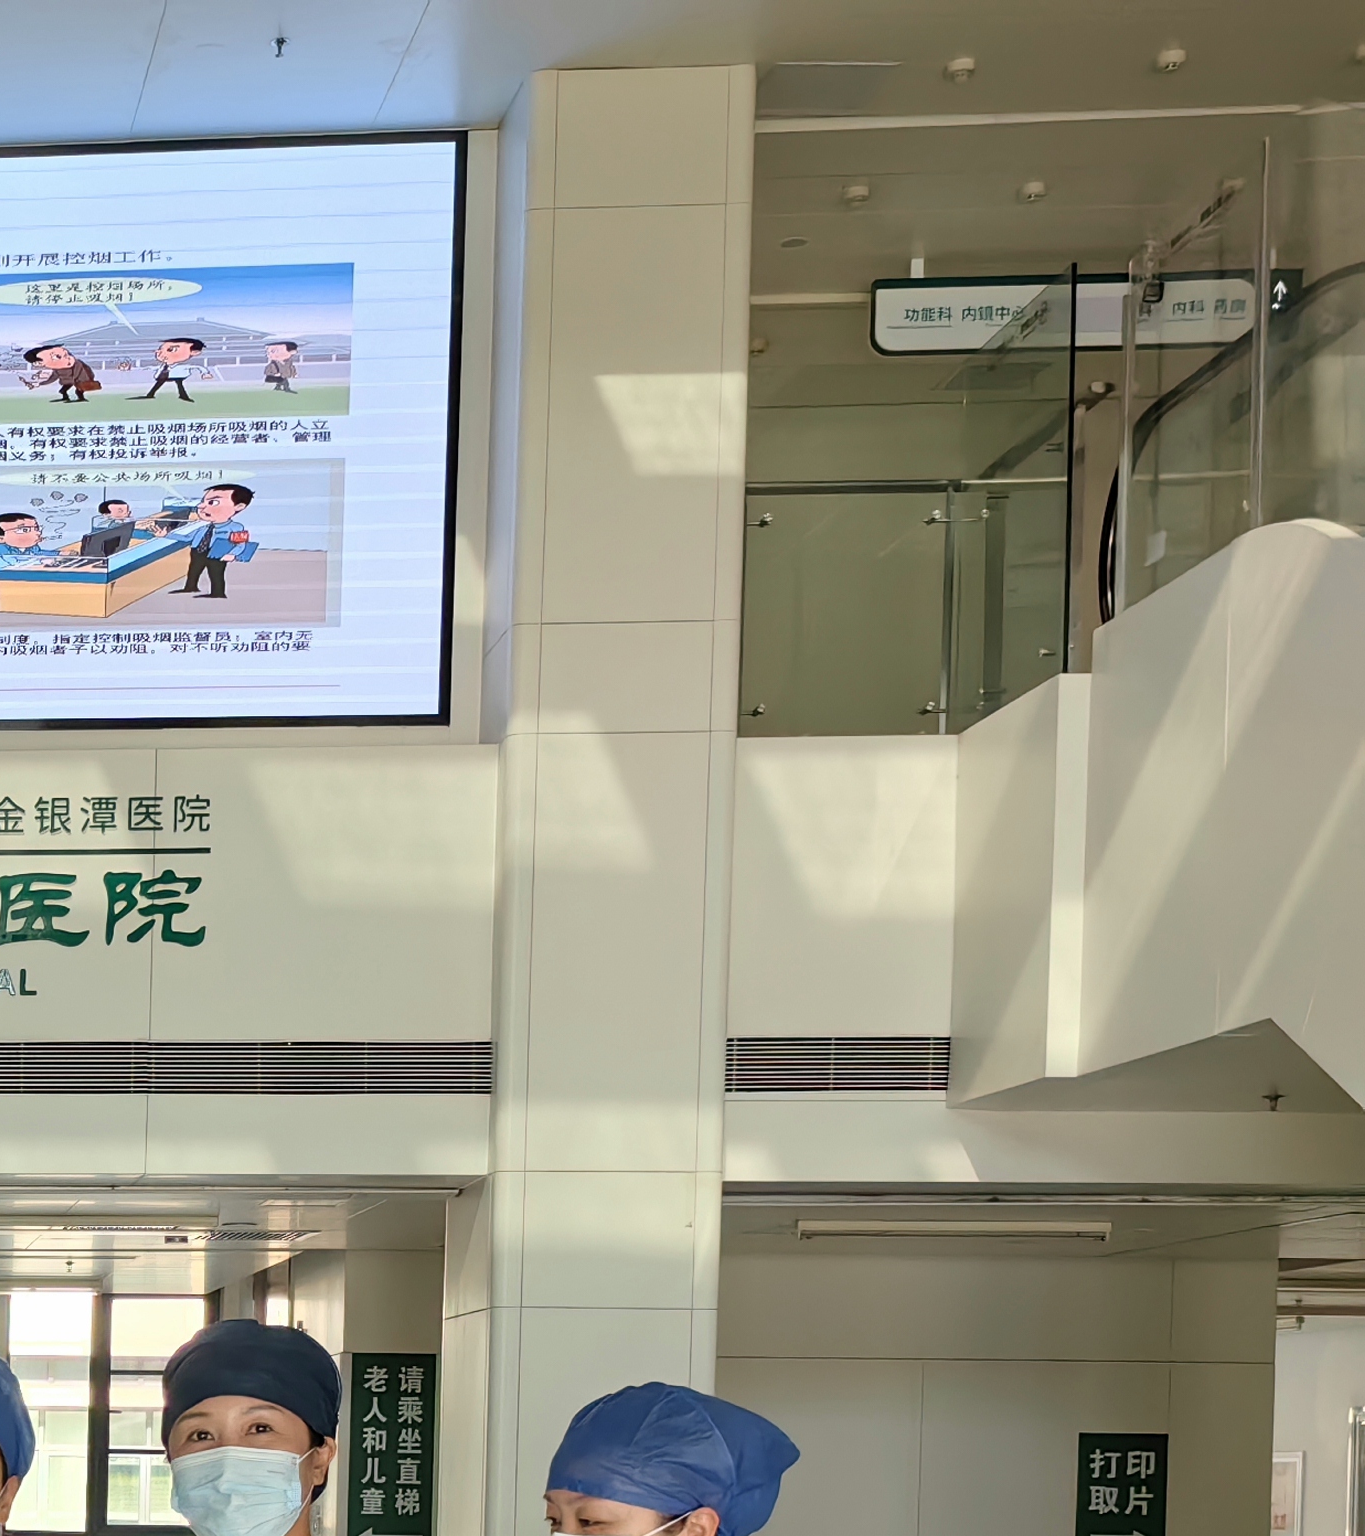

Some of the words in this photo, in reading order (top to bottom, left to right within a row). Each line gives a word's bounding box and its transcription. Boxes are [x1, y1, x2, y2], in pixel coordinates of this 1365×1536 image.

[903, 305, 953, 323] 功能科
[360, 1365, 389, 1515] 老人和儿童
[395, 1366, 425, 1516] 请乘坐直梯
[1089, 1448, 1156, 1479] 打印
[1088, 1485, 1154, 1516] 取片
